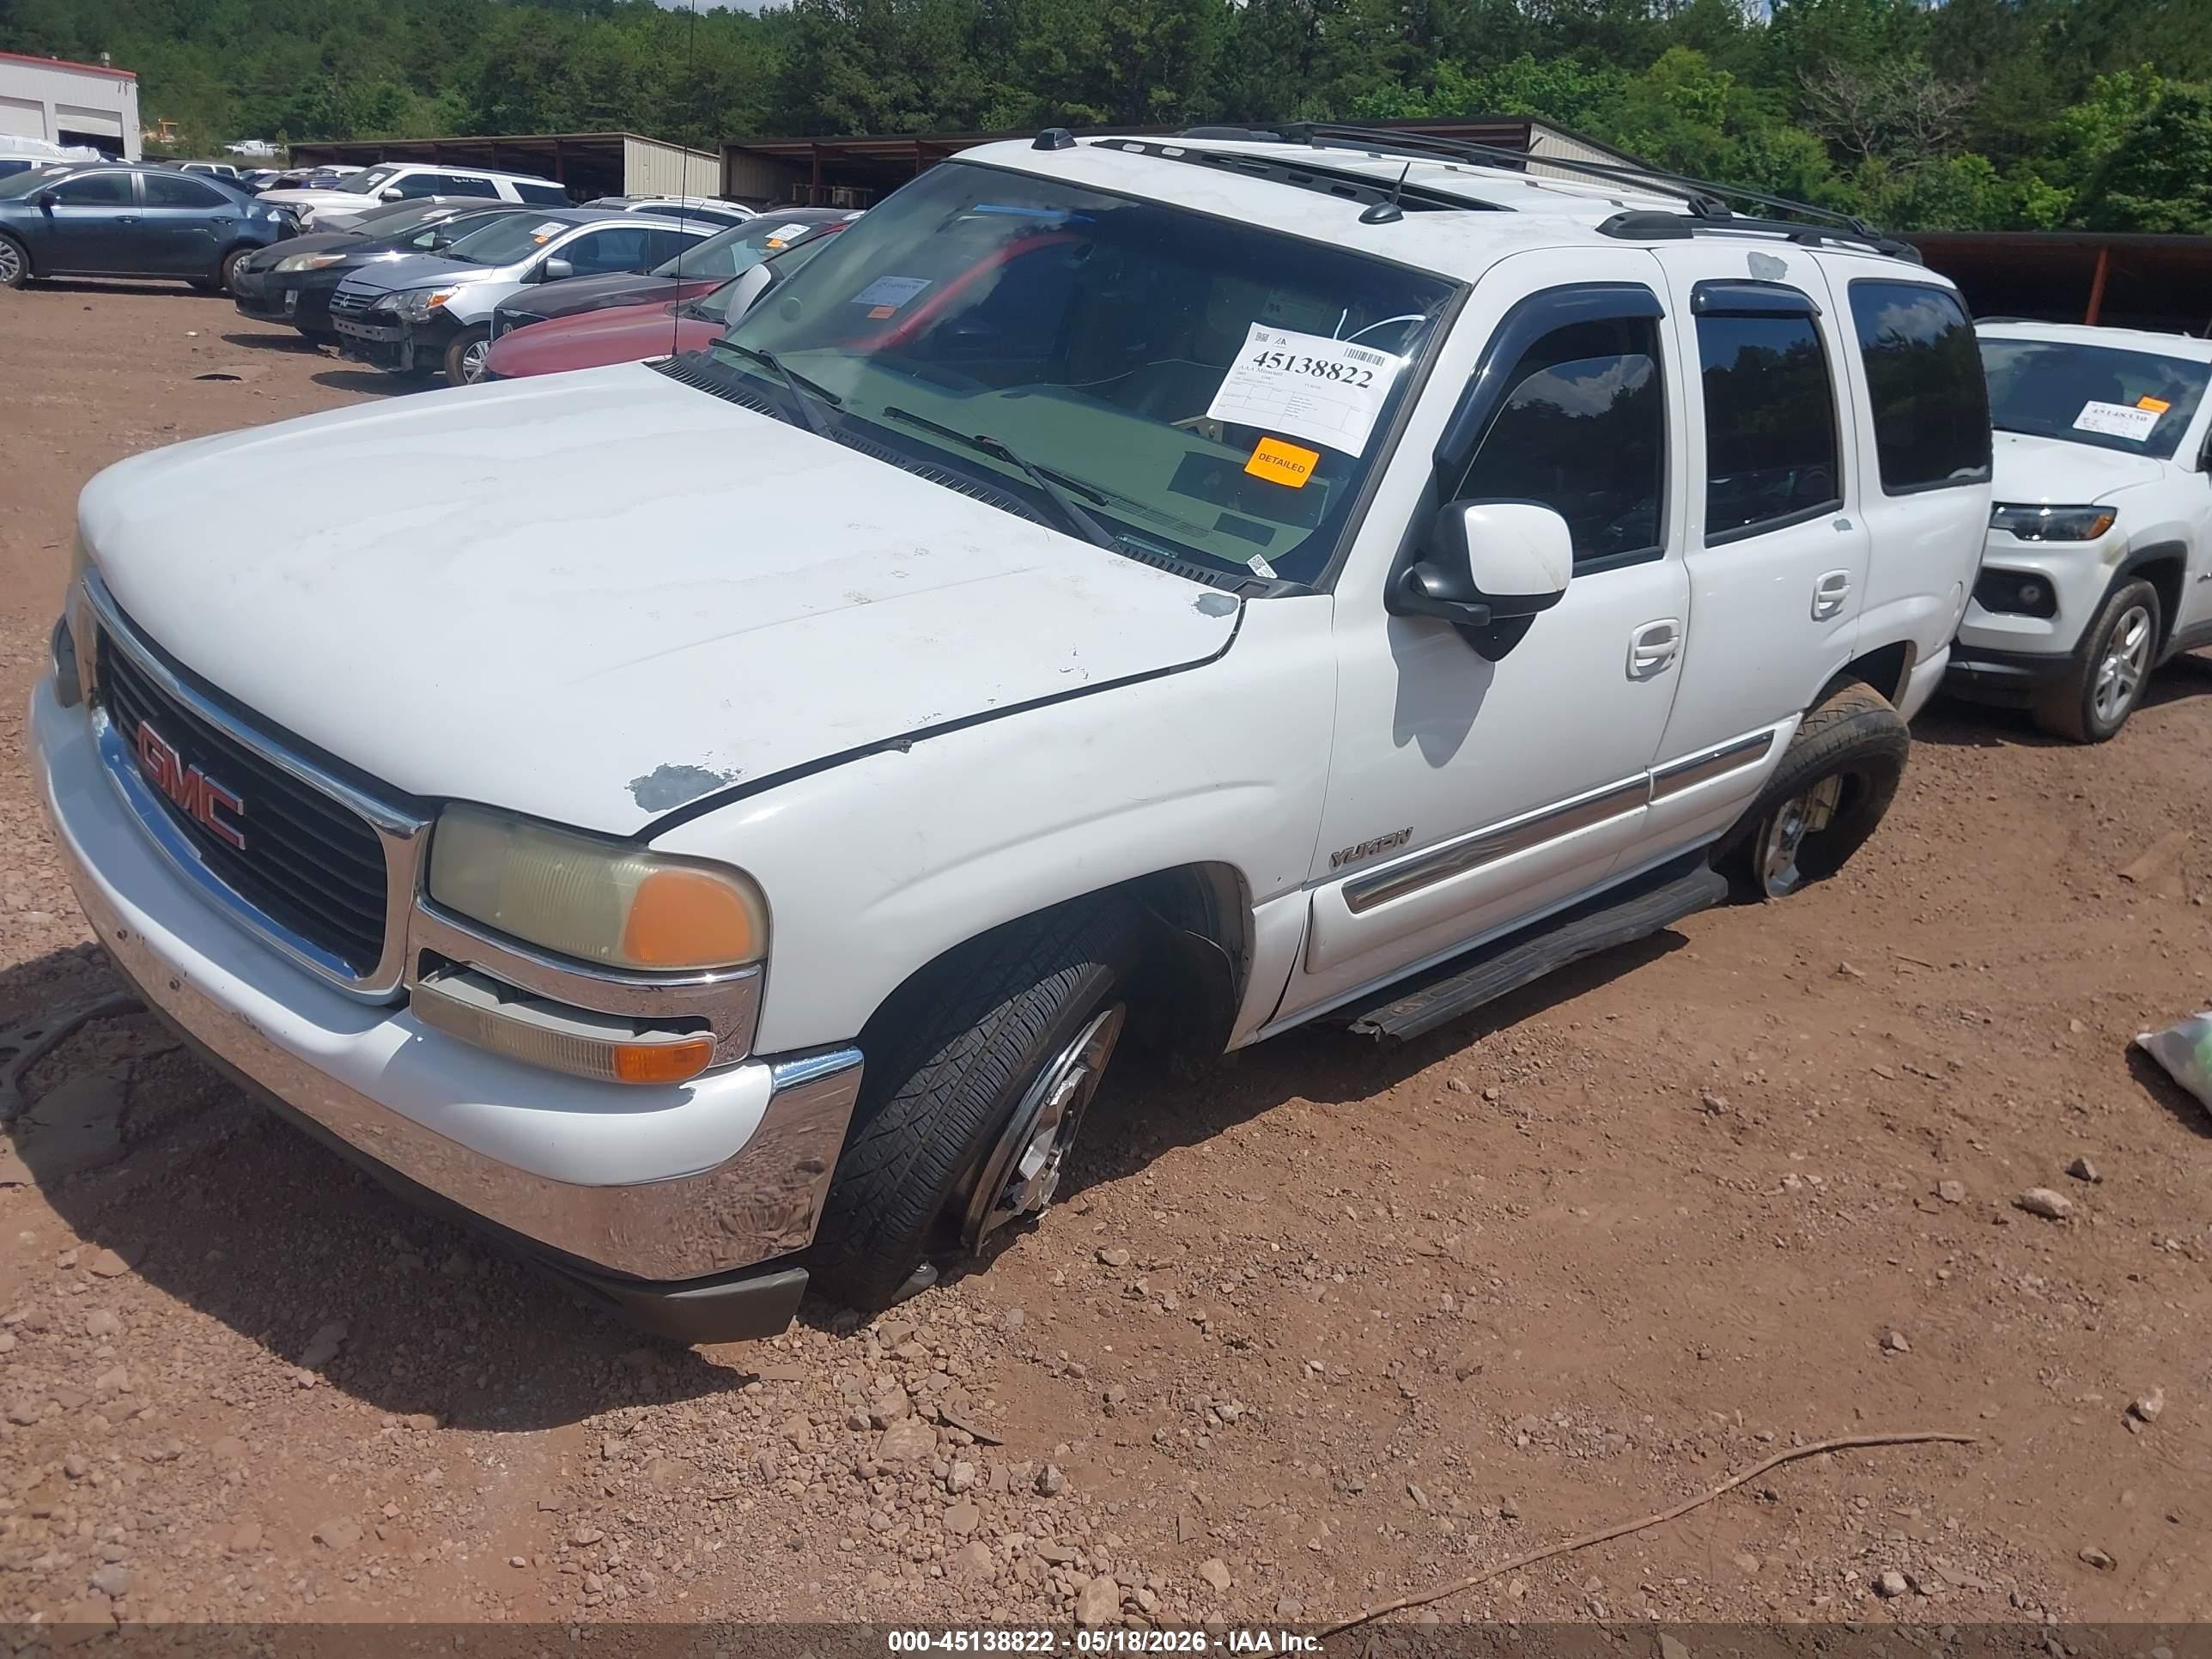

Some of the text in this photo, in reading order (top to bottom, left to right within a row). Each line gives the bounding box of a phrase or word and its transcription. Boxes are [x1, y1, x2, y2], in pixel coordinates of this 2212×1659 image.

[1253, 350, 1373, 388] 45138822
[1258, 452, 1306, 474] DETAILED
[137, 720, 246, 851] GMC
[1329, 826, 1413, 867] YUKON
